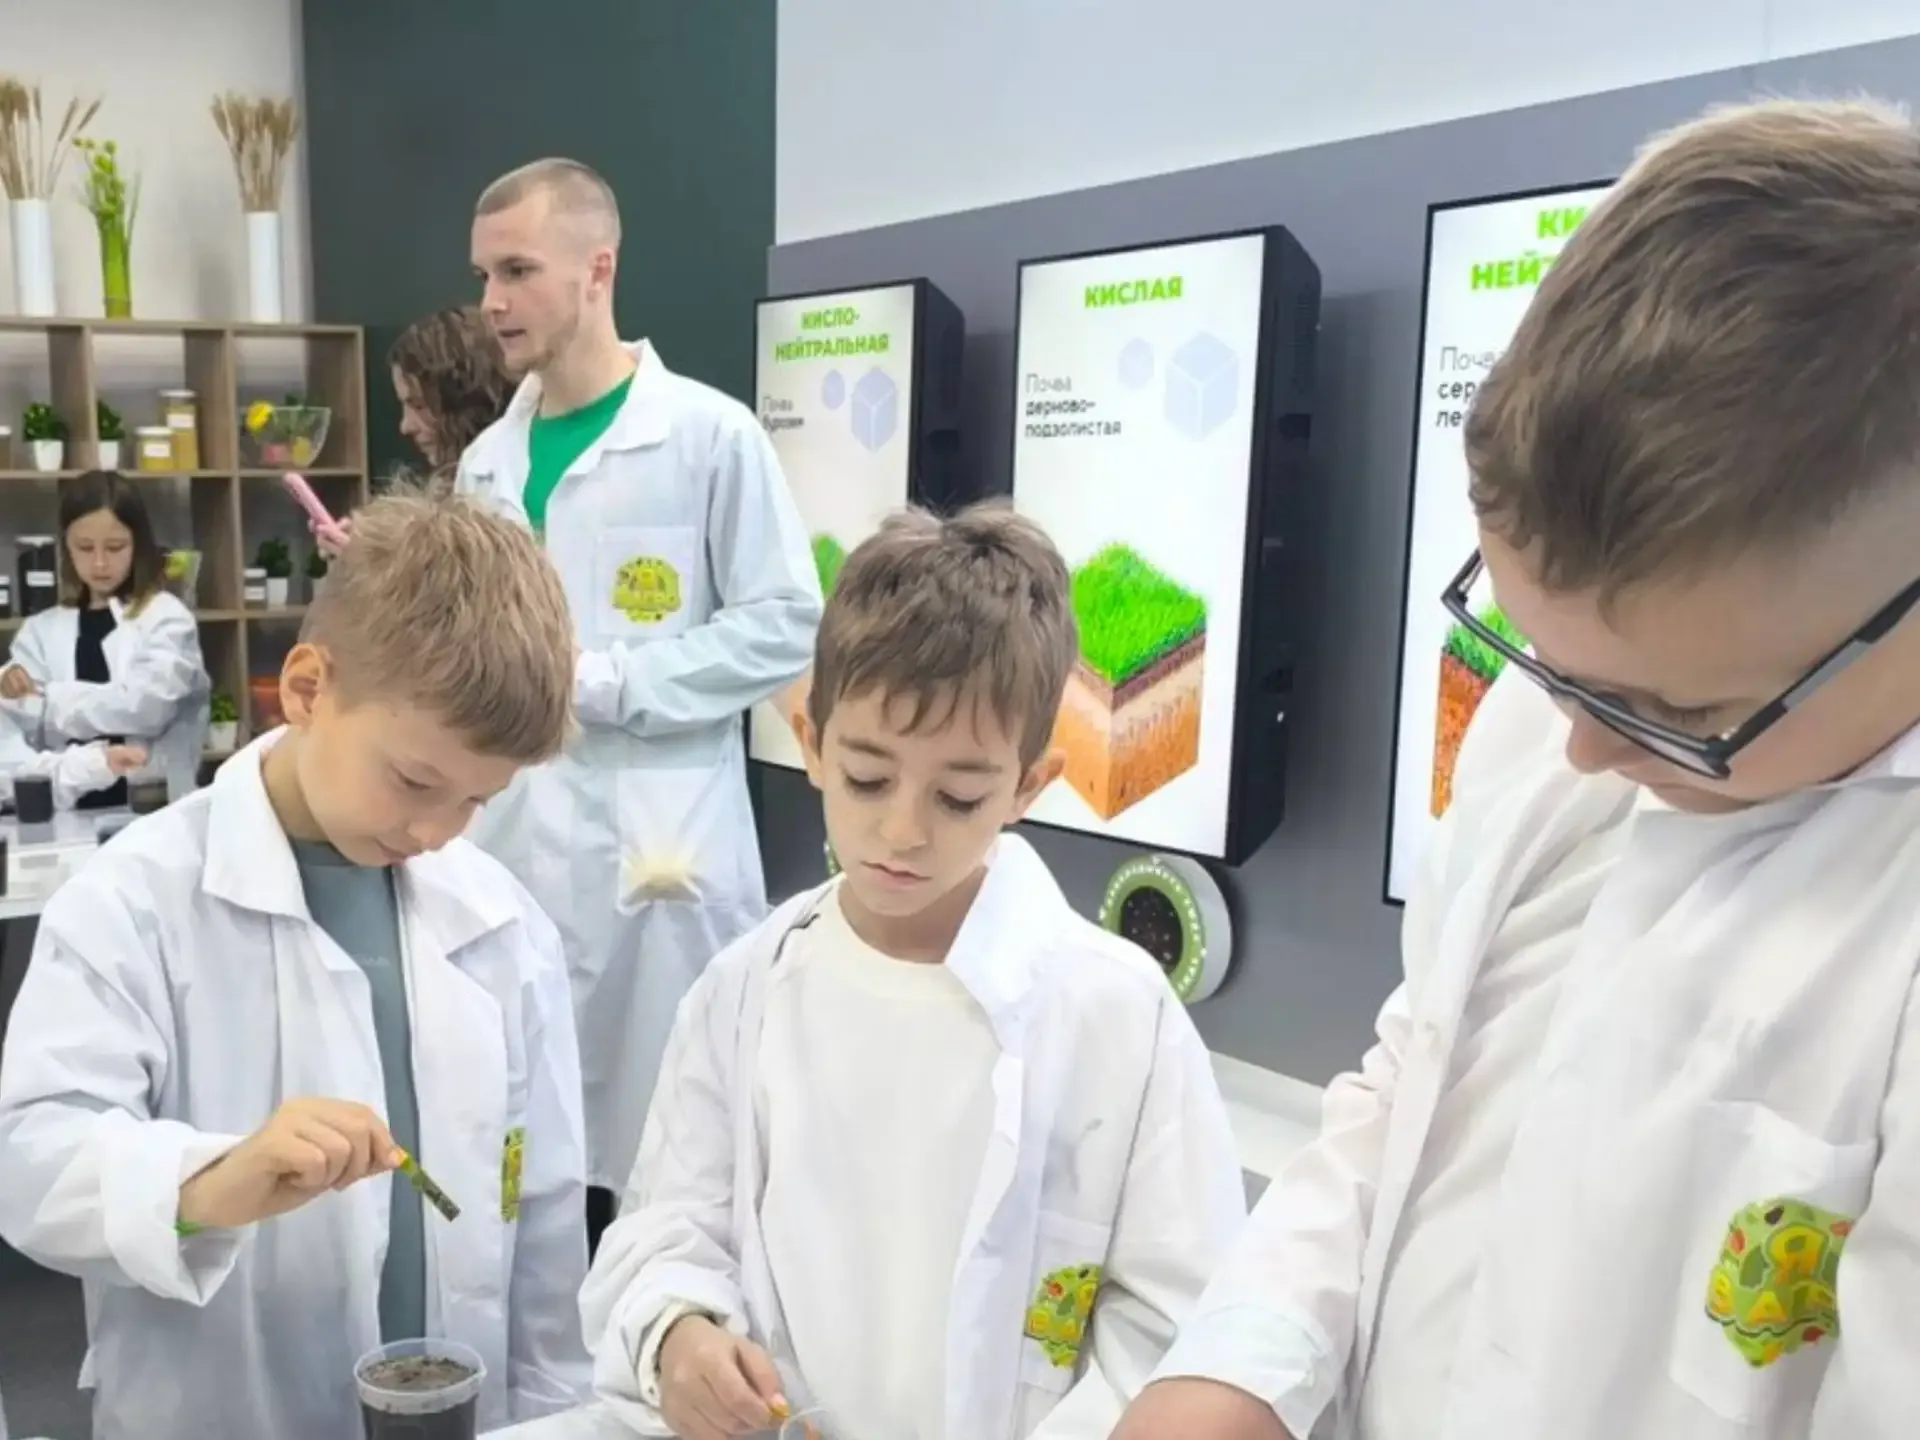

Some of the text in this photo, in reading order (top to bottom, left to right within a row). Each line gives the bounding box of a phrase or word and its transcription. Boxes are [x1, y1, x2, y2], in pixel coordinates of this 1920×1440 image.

[1538, 207, 1587, 239] КИ
[1085, 276, 1183, 308] КИСЛАЯ
[801, 306, 860, 330] КИСЛО-
[776, 333, 890, 363] НЕЙТРАЛЬНАЯ
[1439, 346, 1497, 371] Почв
[1026, 374, 1072, 393] Почва
[1437, 380, 1477, 404] сер
[1027, 400, 1096, 418] дерново-
[1436, 410, 1464, 427] ле
[1025, 421, 1122, 438] подзолистая
[1769, 1224, 1827, 1284] Я
